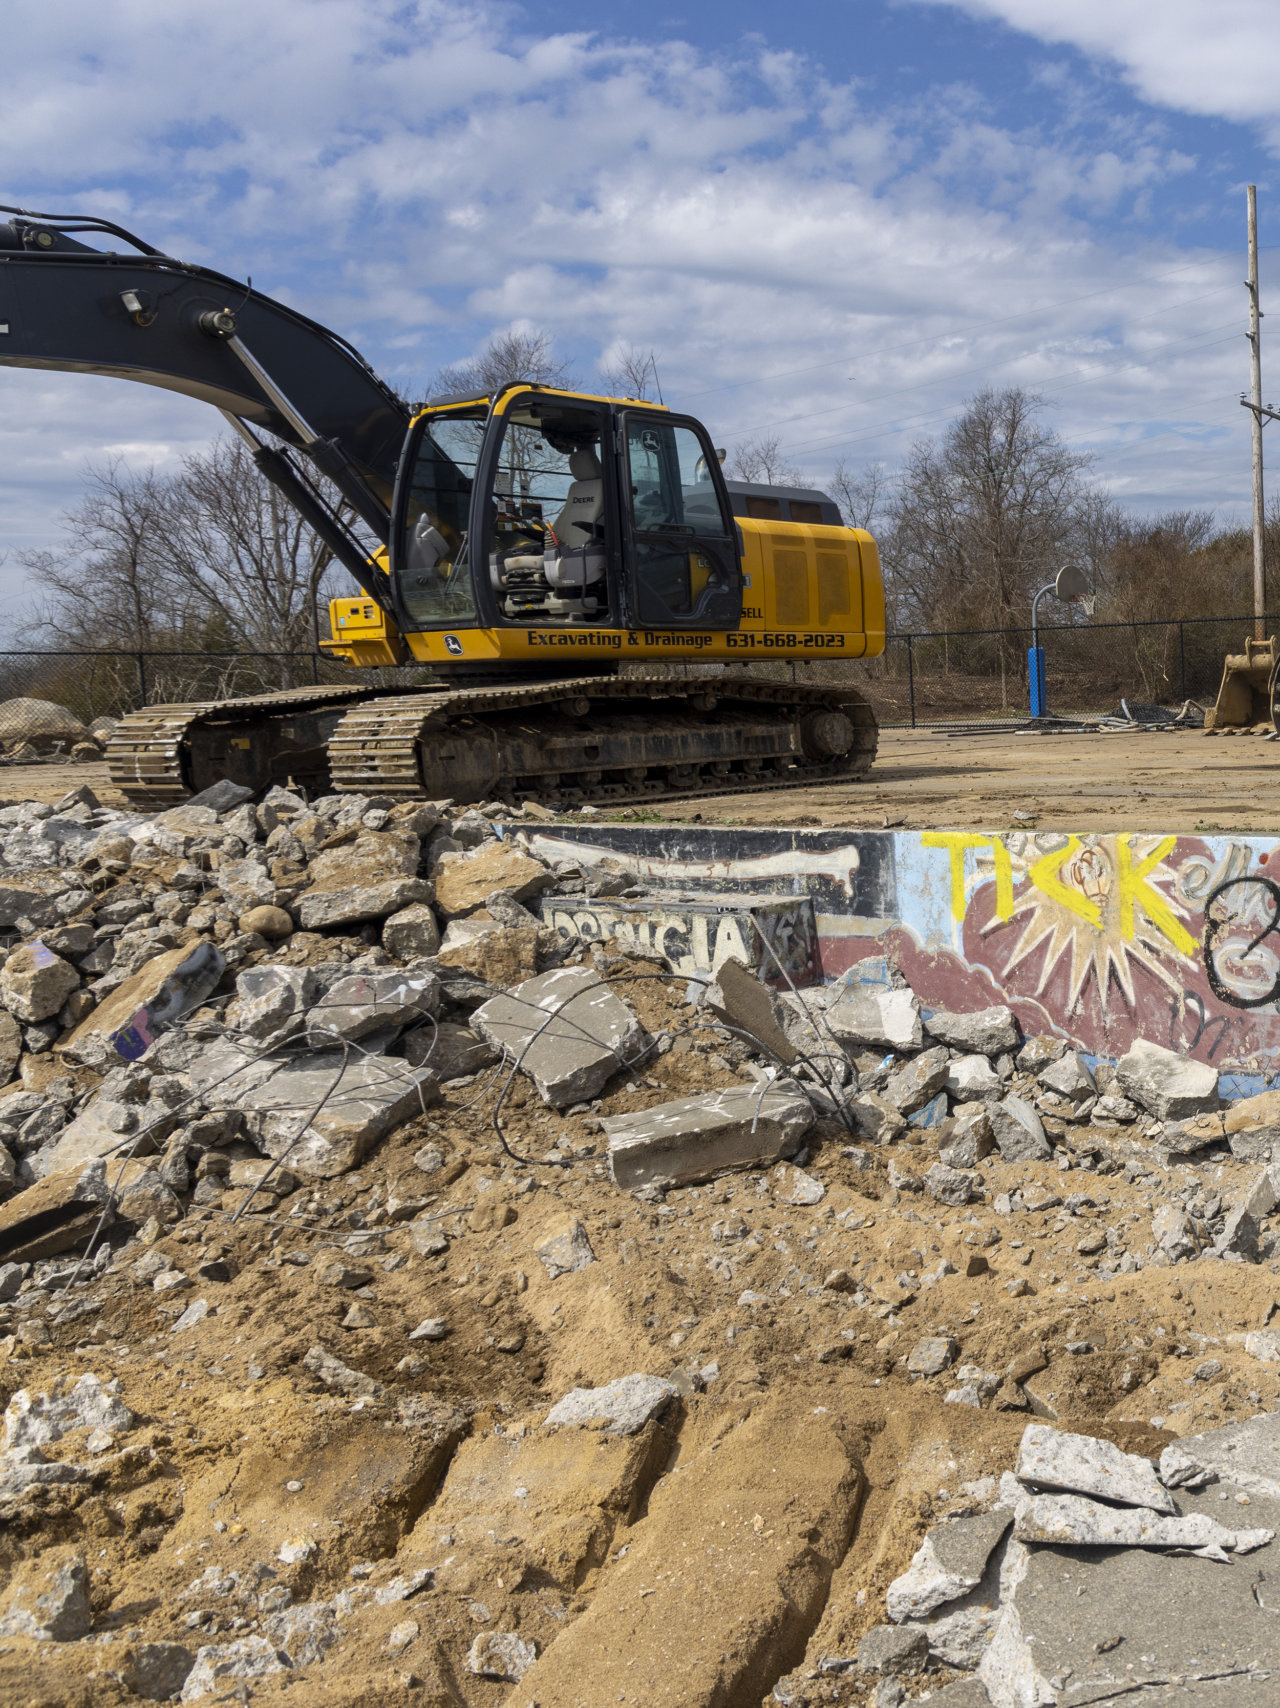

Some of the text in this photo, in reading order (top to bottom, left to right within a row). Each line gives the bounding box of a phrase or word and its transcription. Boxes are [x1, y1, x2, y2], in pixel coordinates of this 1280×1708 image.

[528, 631, 846, 649] Excavating & Drainage 631-668-2023
